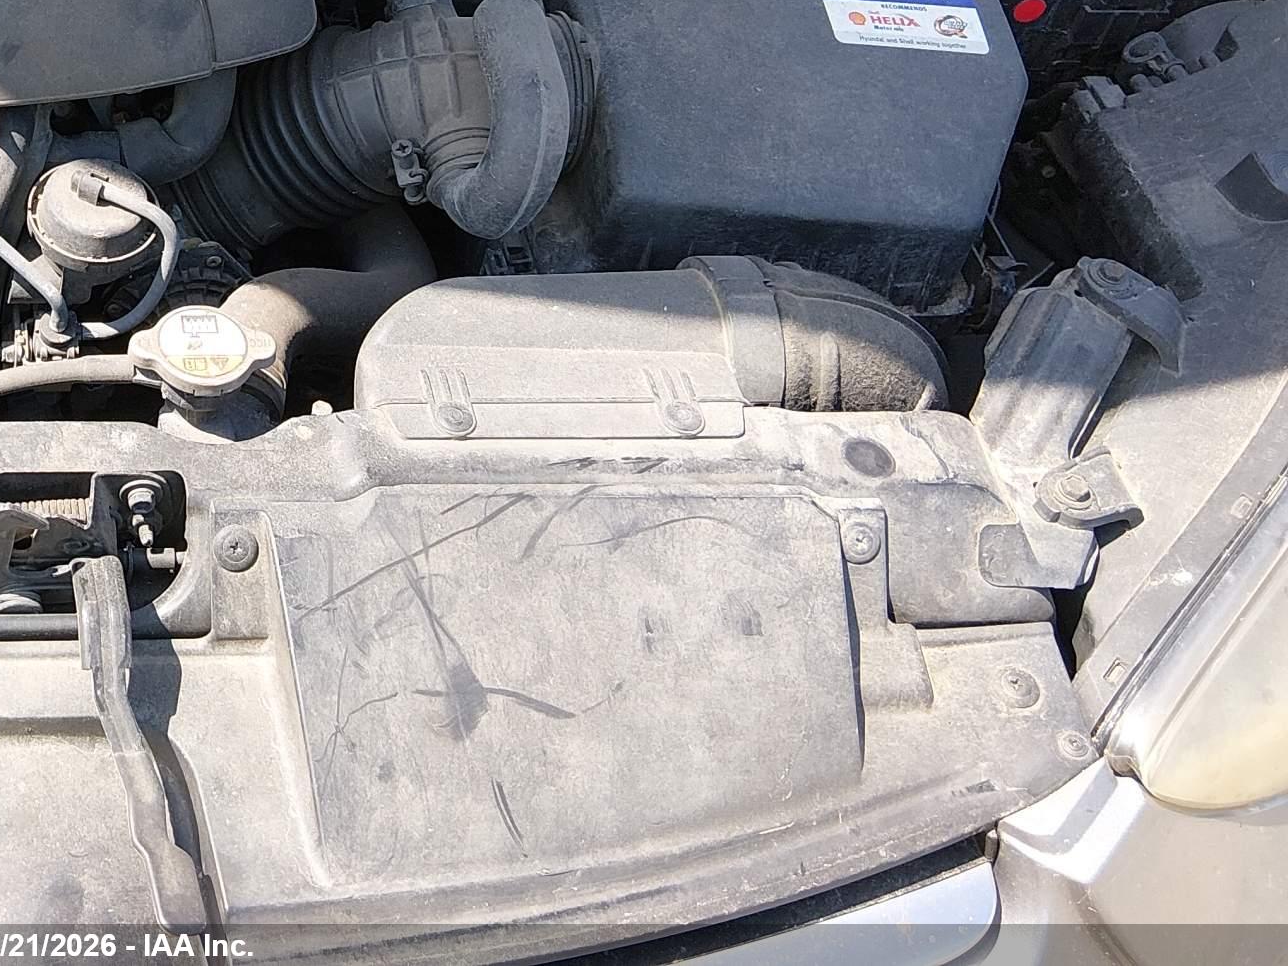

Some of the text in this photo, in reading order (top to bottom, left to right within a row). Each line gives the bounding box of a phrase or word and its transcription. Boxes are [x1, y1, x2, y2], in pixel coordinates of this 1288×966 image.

[880, 3, 928, 12] RECOMMENDS
[870, 14, 921, 27] HELIX
[859, 35, 885, 43] Hyundai
